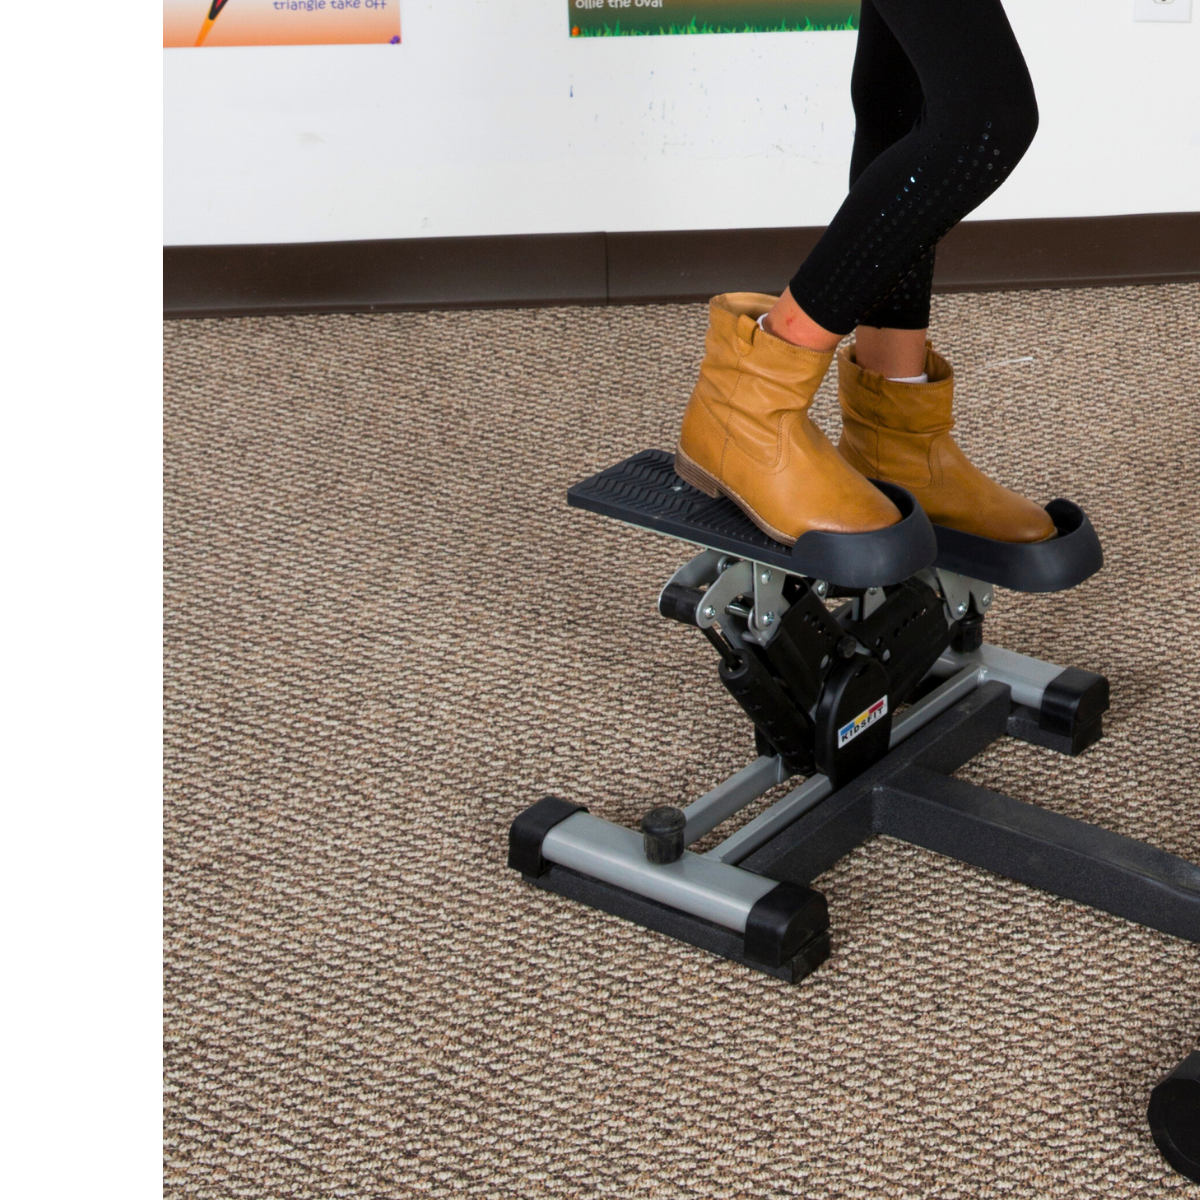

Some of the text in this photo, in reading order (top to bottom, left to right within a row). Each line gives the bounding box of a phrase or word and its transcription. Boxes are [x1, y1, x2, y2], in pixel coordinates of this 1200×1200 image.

[273, 0, 326, 11] triangle
[330, 0, 361, 10] take
[842, 707, 883, 742] KIDSFIT
